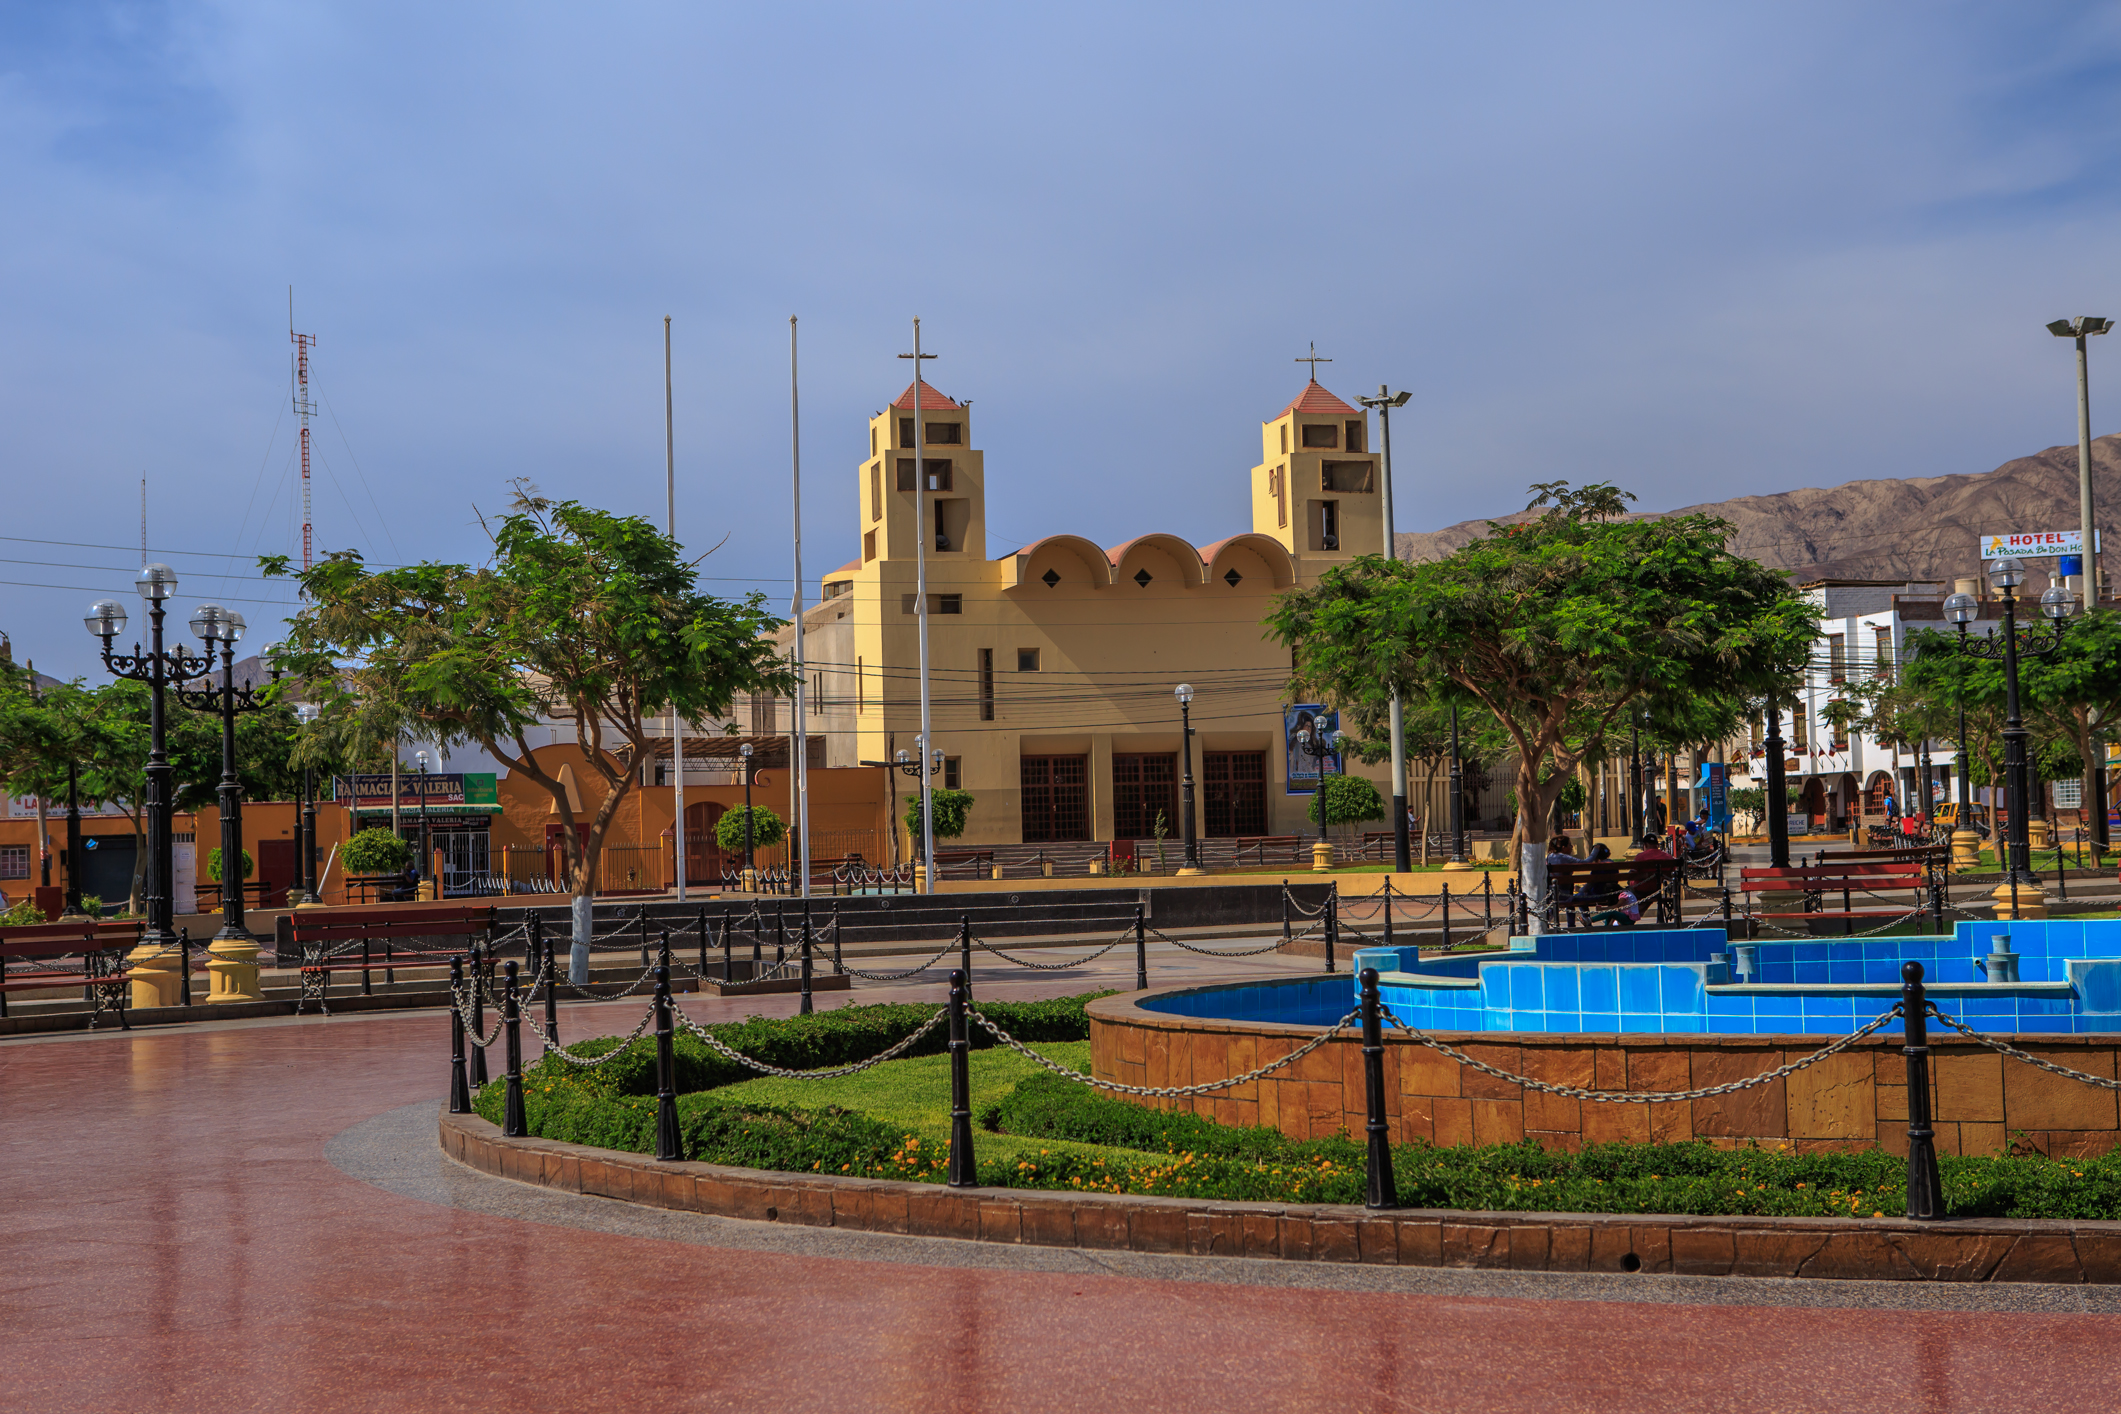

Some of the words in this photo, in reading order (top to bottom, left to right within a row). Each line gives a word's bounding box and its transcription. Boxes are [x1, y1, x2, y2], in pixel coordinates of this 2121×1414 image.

[2010, 533, 2065, 546] HOTEL
[2049, 545, 2067, 553] DON
[447, 793, 464, 801] SAC
